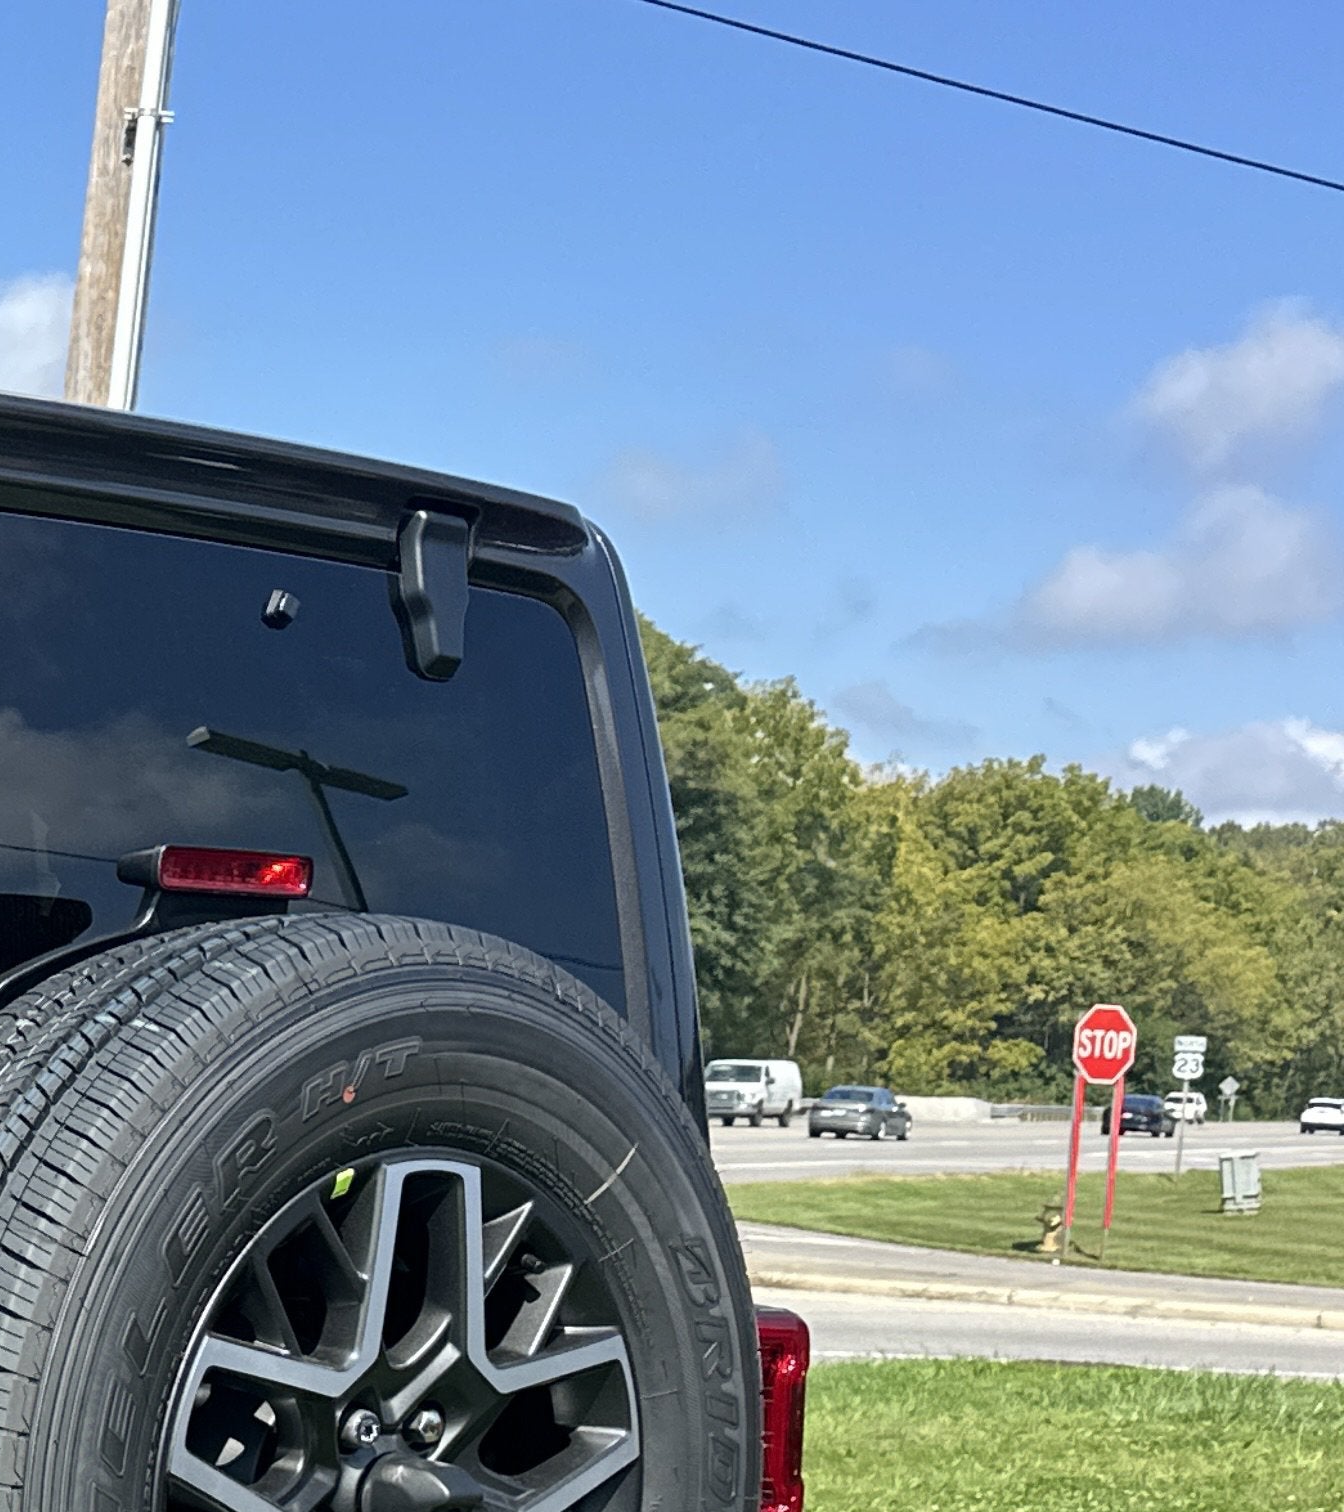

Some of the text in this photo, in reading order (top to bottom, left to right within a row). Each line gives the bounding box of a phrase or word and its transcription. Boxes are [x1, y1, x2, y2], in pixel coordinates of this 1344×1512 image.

[1078, 1028, 1132, 1060] STOP
[300, 1035, 424, 1123] H/T
[1176, 1057, 1200, 1074] 23
